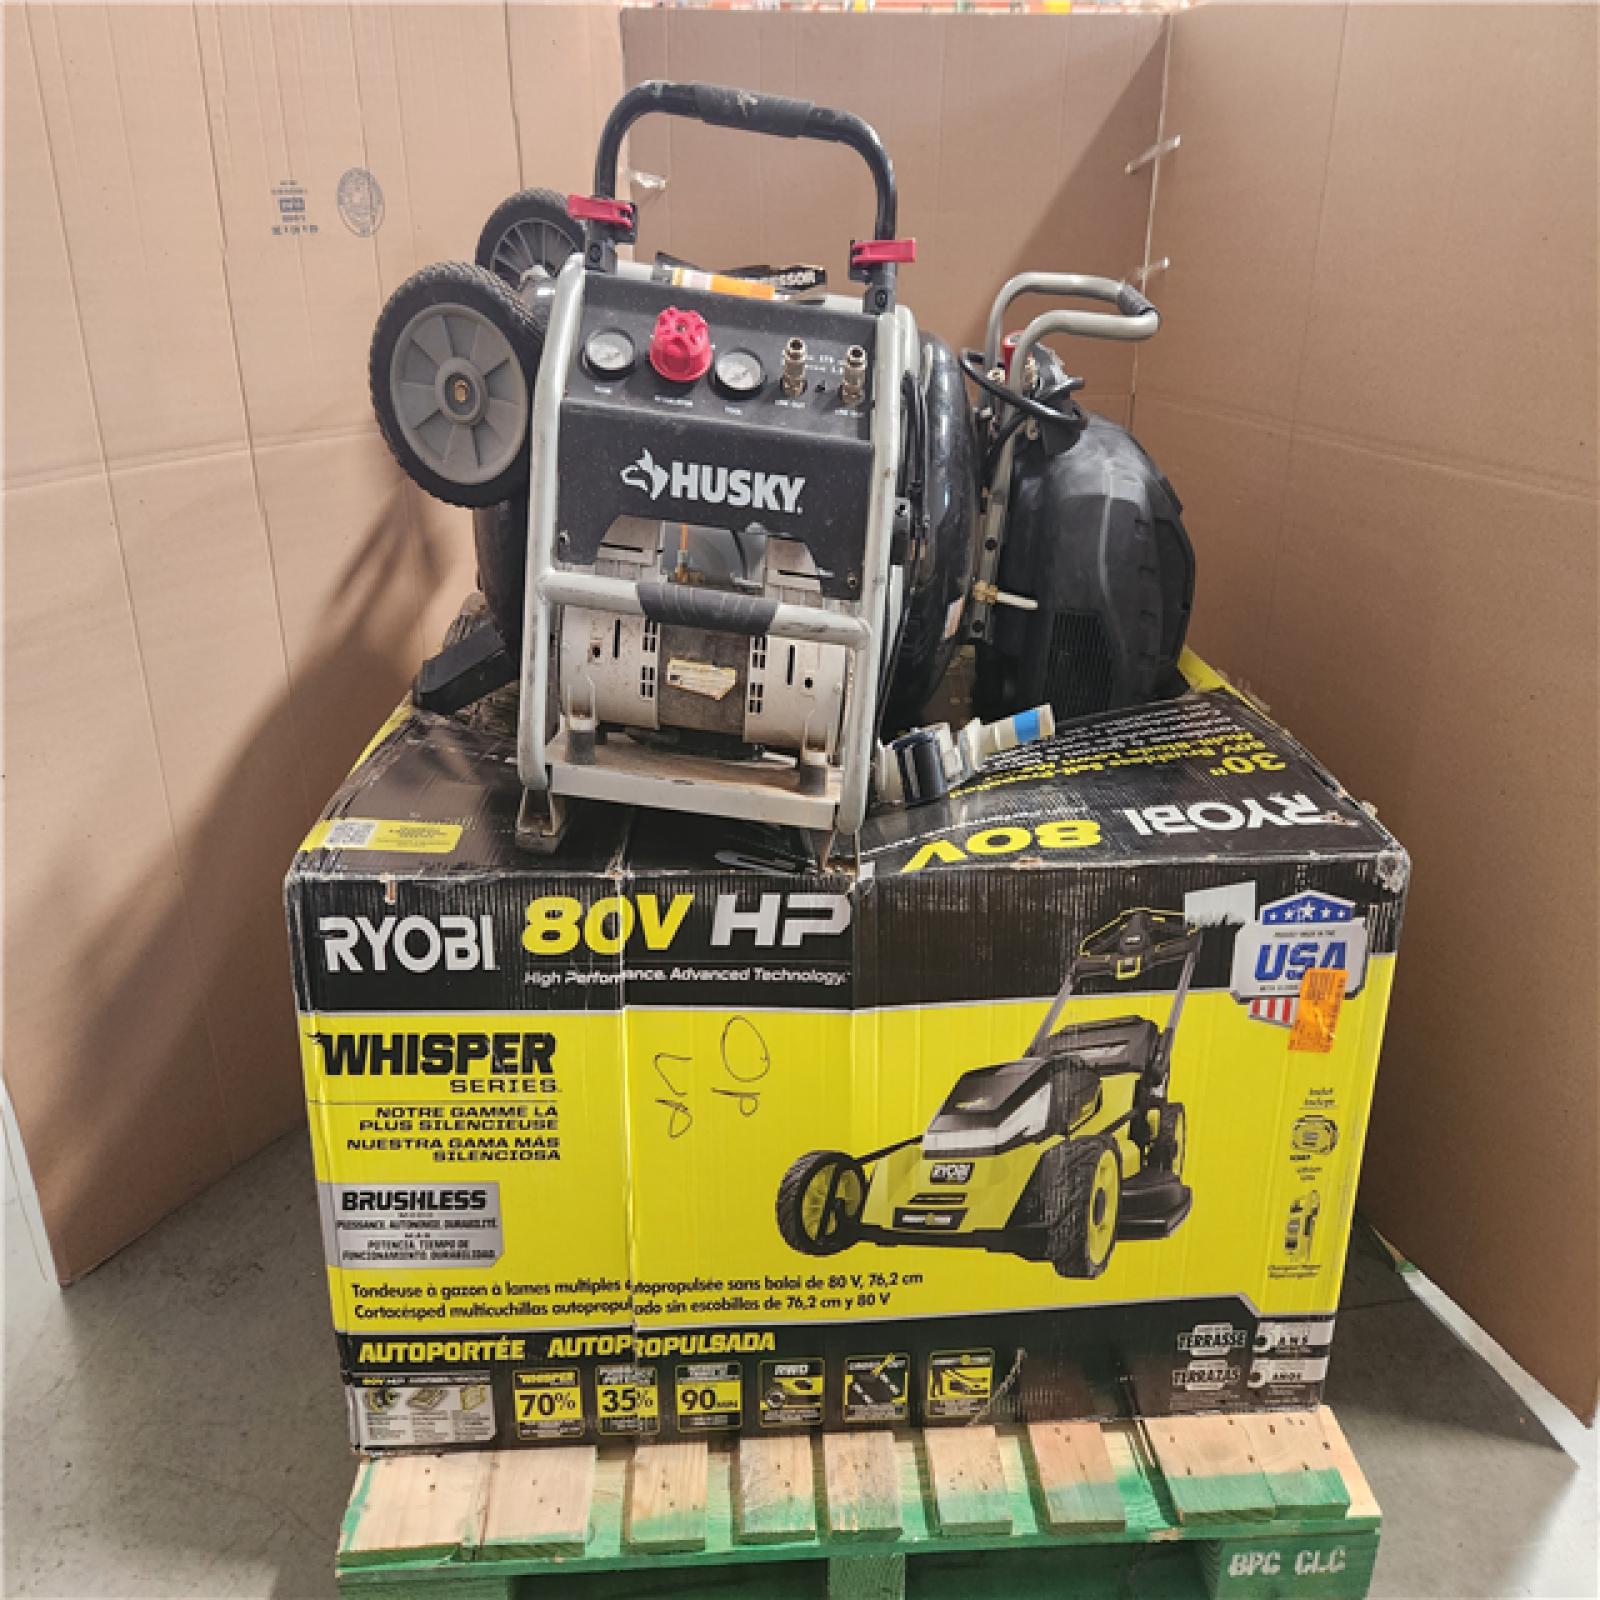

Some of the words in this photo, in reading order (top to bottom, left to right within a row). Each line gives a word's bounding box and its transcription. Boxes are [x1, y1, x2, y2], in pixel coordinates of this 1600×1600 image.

[671, 461, 805, 514] HUSKY
[1124, 793, 1320, 837] RYOBI
[901, 819, 1101, 873] 80V
[319, 914, 495, 973] RYOBI
[521, 893, 696, 955] 80V
[709, 893, 851, 947] HP
[1255, 942, 1346, 981] USA
[524, 971, 561, 988] High
[670, 966, 750, 982] Advanced
[319, 1032, 556, 1076] WHISPER
[359, 1119, 413, 1131] PLUS
[419, 1119, 559, 1131] SILENCIEUSE
[376, 1106, 445, 1119] NOTRE
[450, 1106, 528, 1118] GAMME
[534, 1106, 558, 1117] LA
[347, 1136, 443, 1151] NUESTRA
[448, 1136, 509, 1149] GAMA
[433, 1149, 561, 1163] SILENCIOSA
[341, 1189, 488, 1211] BRUSHLESS
[352, 1283, 422, 1298] Tondeuse
[427, 1285, 437, 1297] à
[441, 1285, 488, 1300] gazon
[492, 1285, 502, 1296] à
[505, 1280, 550, 1296] lames
[554, 1277, 621, 1296] multiples
[727, 1279, 761, 1291] sans
[764, 1275, 801, 1290] balai
[805, 1275, 825, 1290] de
[827, 1274, 846, 1289] 80
[850, 1274, 863, 1290] V,
[868, 1272, 899, 1289] 76,2
[902, 1272, 924, 1286] cm
[354, 1302, 446, 1321] Cortacésped
[449, 1300, 549, 1318] multicuchillas
[665, 1298, 687, 1314] sin
[690, 1296, 760, 1312] escobillas
[764, 1295, 783, 1311] de
[787, 1294, 817, 1311] 76,2
[820, 1297, 842, 1309] cm
[844, 1296, 852, 1310] y
[856, 1293, 876, 1307] 80
[878, 1292, 891, 1306] V
[358, 1335, 526, 1363] AUTOPORTÉE
[518, 1392, 576, 1417] 70%
[602, 1389, 655, 1413] 35%
[681, 1389, 717, 1411] 90
